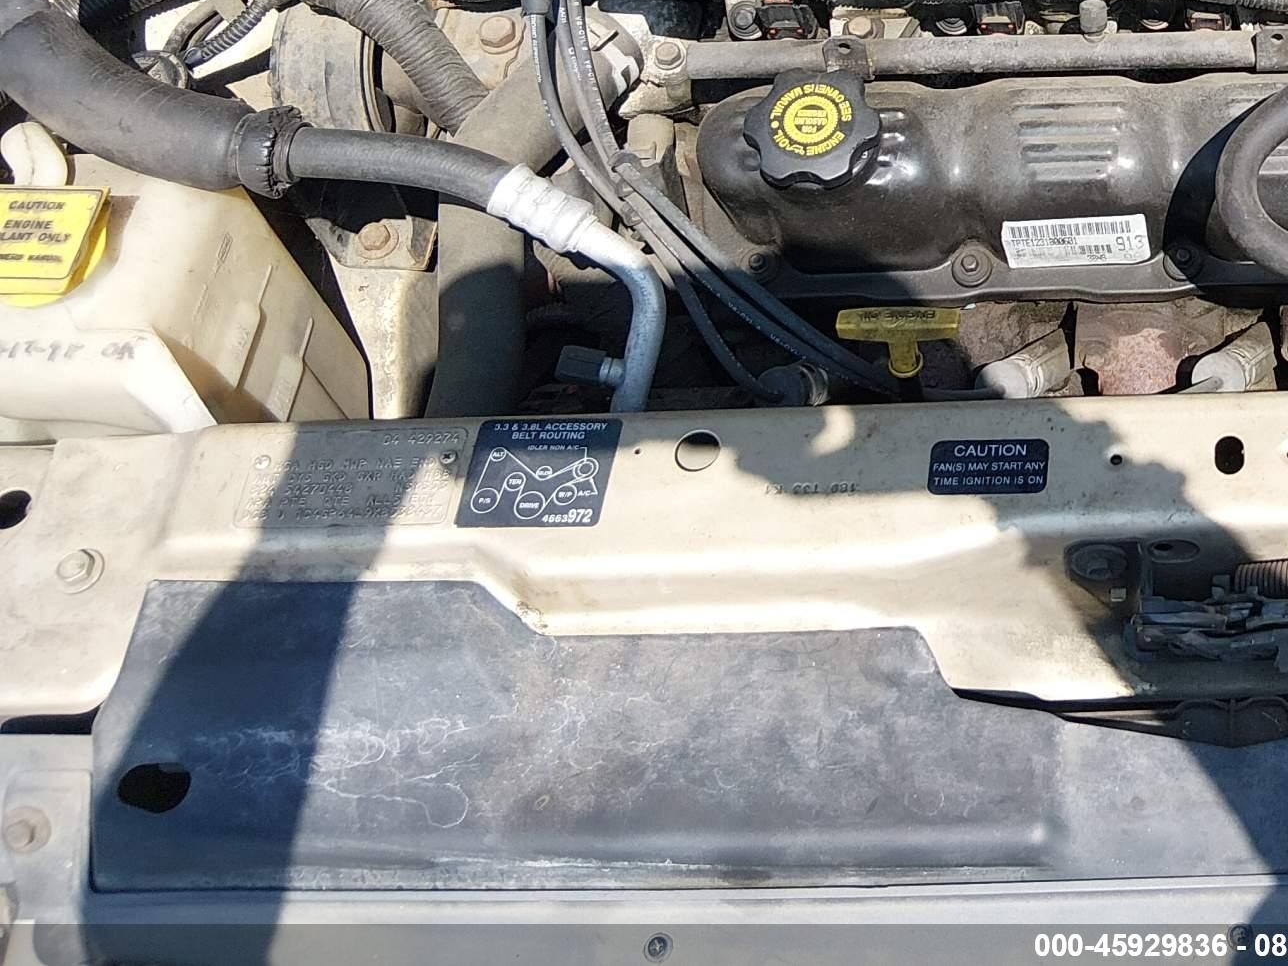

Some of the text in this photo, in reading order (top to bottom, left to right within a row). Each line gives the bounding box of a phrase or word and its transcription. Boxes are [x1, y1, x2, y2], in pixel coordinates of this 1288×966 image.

[770, 86, 803, 119] MANUAL
[838, 101, 853, 122] SEE
[773, 129, 846, 155] ENGINE OIL
[8, 200, 66, 210] CAUTION
[4, 219, 53, 229] ENGINE
[38, 233, 72, 243] ONLY
[494, 423, 509, 431] 3.3
[512, 423, 519, 431] &
[544, 422, 608, 431] ACCESSORY
[511, 431, 585, 440] BELT ROUTING
[953, 444, 1027, 457] CAUTION
[933, 461, 1046, 473] FAN(S) MAY START ANY
[934, 475, 1043, 486] TIME IGNITION IS ON
[541, 508, 593, 523] 4663972
